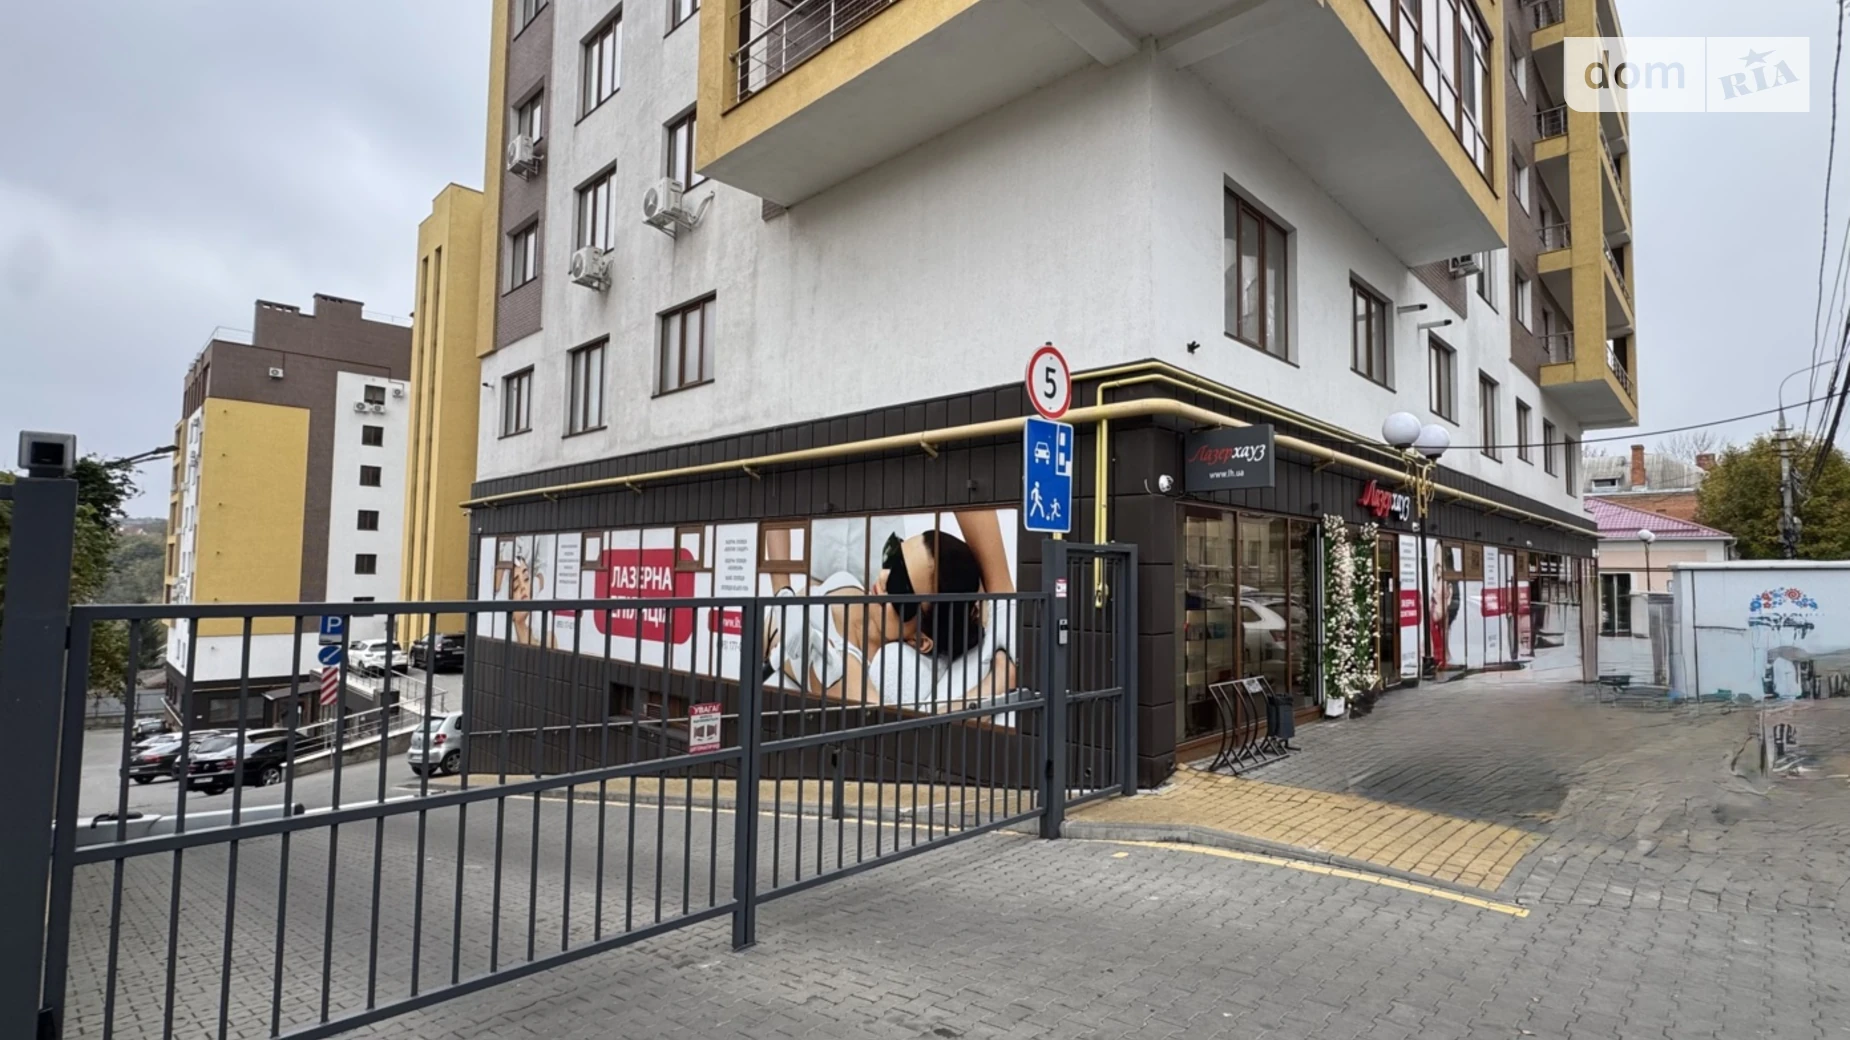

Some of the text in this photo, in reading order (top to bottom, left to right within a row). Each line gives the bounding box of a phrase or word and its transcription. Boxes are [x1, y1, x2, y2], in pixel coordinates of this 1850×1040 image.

[1044, 366, 1057, 399] 5
[1188, 444, 1266, 466] Лазерхауз
[1209, 468, 1245, 479] www.lh.ua
[611, 566, 672, 591] ЛАЗЕРНА
[327, 616, 342, 633] P
